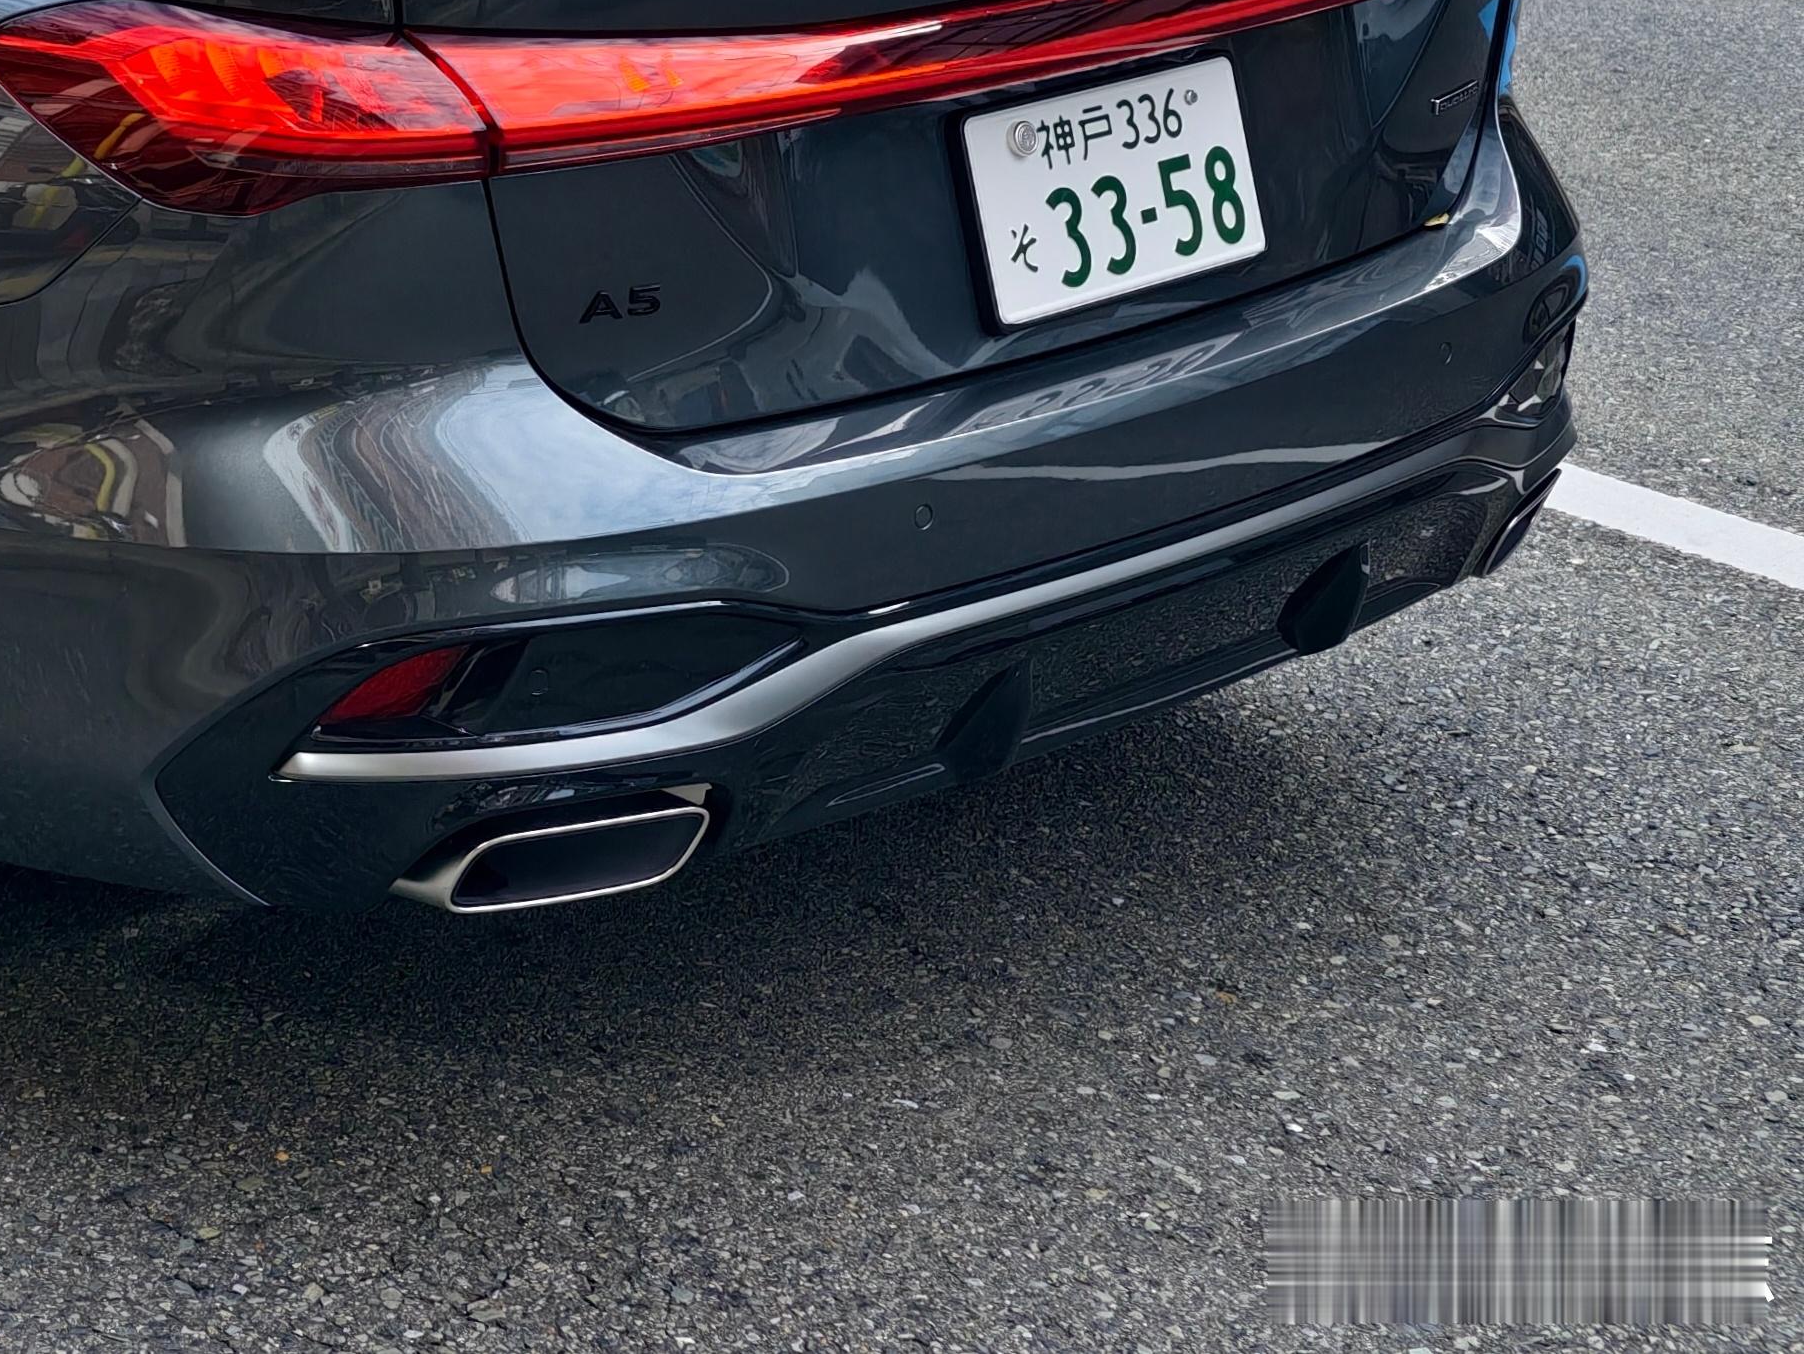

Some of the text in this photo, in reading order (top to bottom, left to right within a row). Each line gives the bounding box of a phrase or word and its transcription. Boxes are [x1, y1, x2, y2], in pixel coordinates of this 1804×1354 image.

[1036, 88, 1183, 170] 神戸 336
[1010, 145, 1246, 288] そ 33-58
[578, 282, 661, 324] A5
